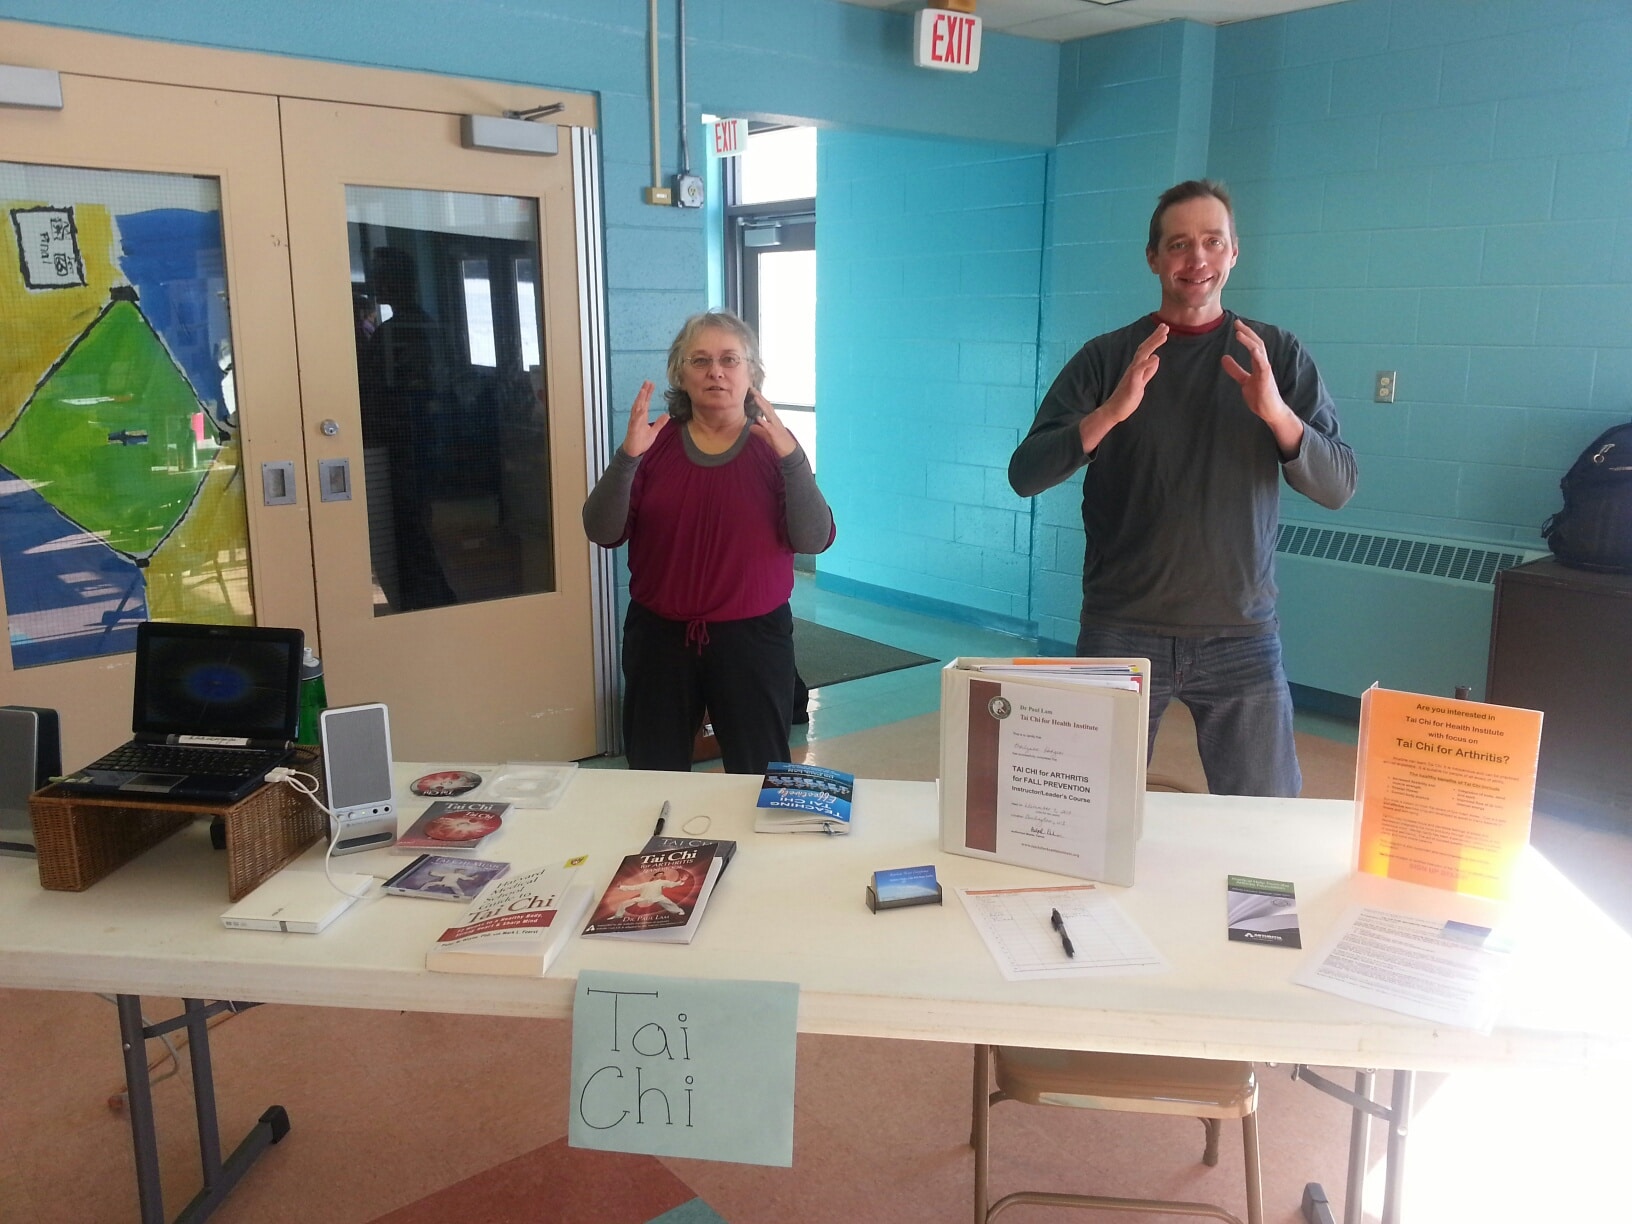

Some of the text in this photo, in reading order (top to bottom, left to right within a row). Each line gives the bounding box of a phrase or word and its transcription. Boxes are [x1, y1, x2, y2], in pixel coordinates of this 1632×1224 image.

[931, 14, 976, 65] EXIT
[714, 119, 738, 154] EXIT
[1416, 703, 1430, 711] Are
[1432, 706, 1446, 715] you
[1447, 707, 1487, 720] interested
[1030, 715, 1041, 723] Chi
[1052, 719, 1072, 728] Health
[1073, 722, 1099, 731] Institute
[1419, 717, 1432, 726] Chi
[1433, 720, 1444, 728] for
[1445, 722, 1471, 732] Health
[1472, 726, 1505, 737] Institute
[1428, 731, 1444, 740] with
[1446, 733, 1467, 743] focus
[1396, 738, 1510, 765] Tai Chi for Arthritis?
[1012, 765, 1089, 783] TAI CHI for ARTHRITIS
[1012, 775, 1091, 794] for FALL PREVENTION
[776, 788, 837, 804] Effectively
[779, 796, 831, 809] TAI CHI
[1012, 785, 1091, 804] Instructor/Leader's Course
[445, 802, 494, 811] Tai Chi
[769, 801, 844, 819] TEACHING
[477, 812, 495, 820] Chi
[661, 838, 683, 846] TAI
[640, 849, 698, 864] Tai Chi
[651, 859, 694, 868] ARTHRITIS
[491, 877, 539, 896] Medical
[496, 868, 546, 889] Harvard
[468, 895, 556, 923] Tai Chi
[500, 914, 524, 923] Healthy
[587, 986, 692, 1061] Tai
[580, 1065, 694, 1130] Chi
